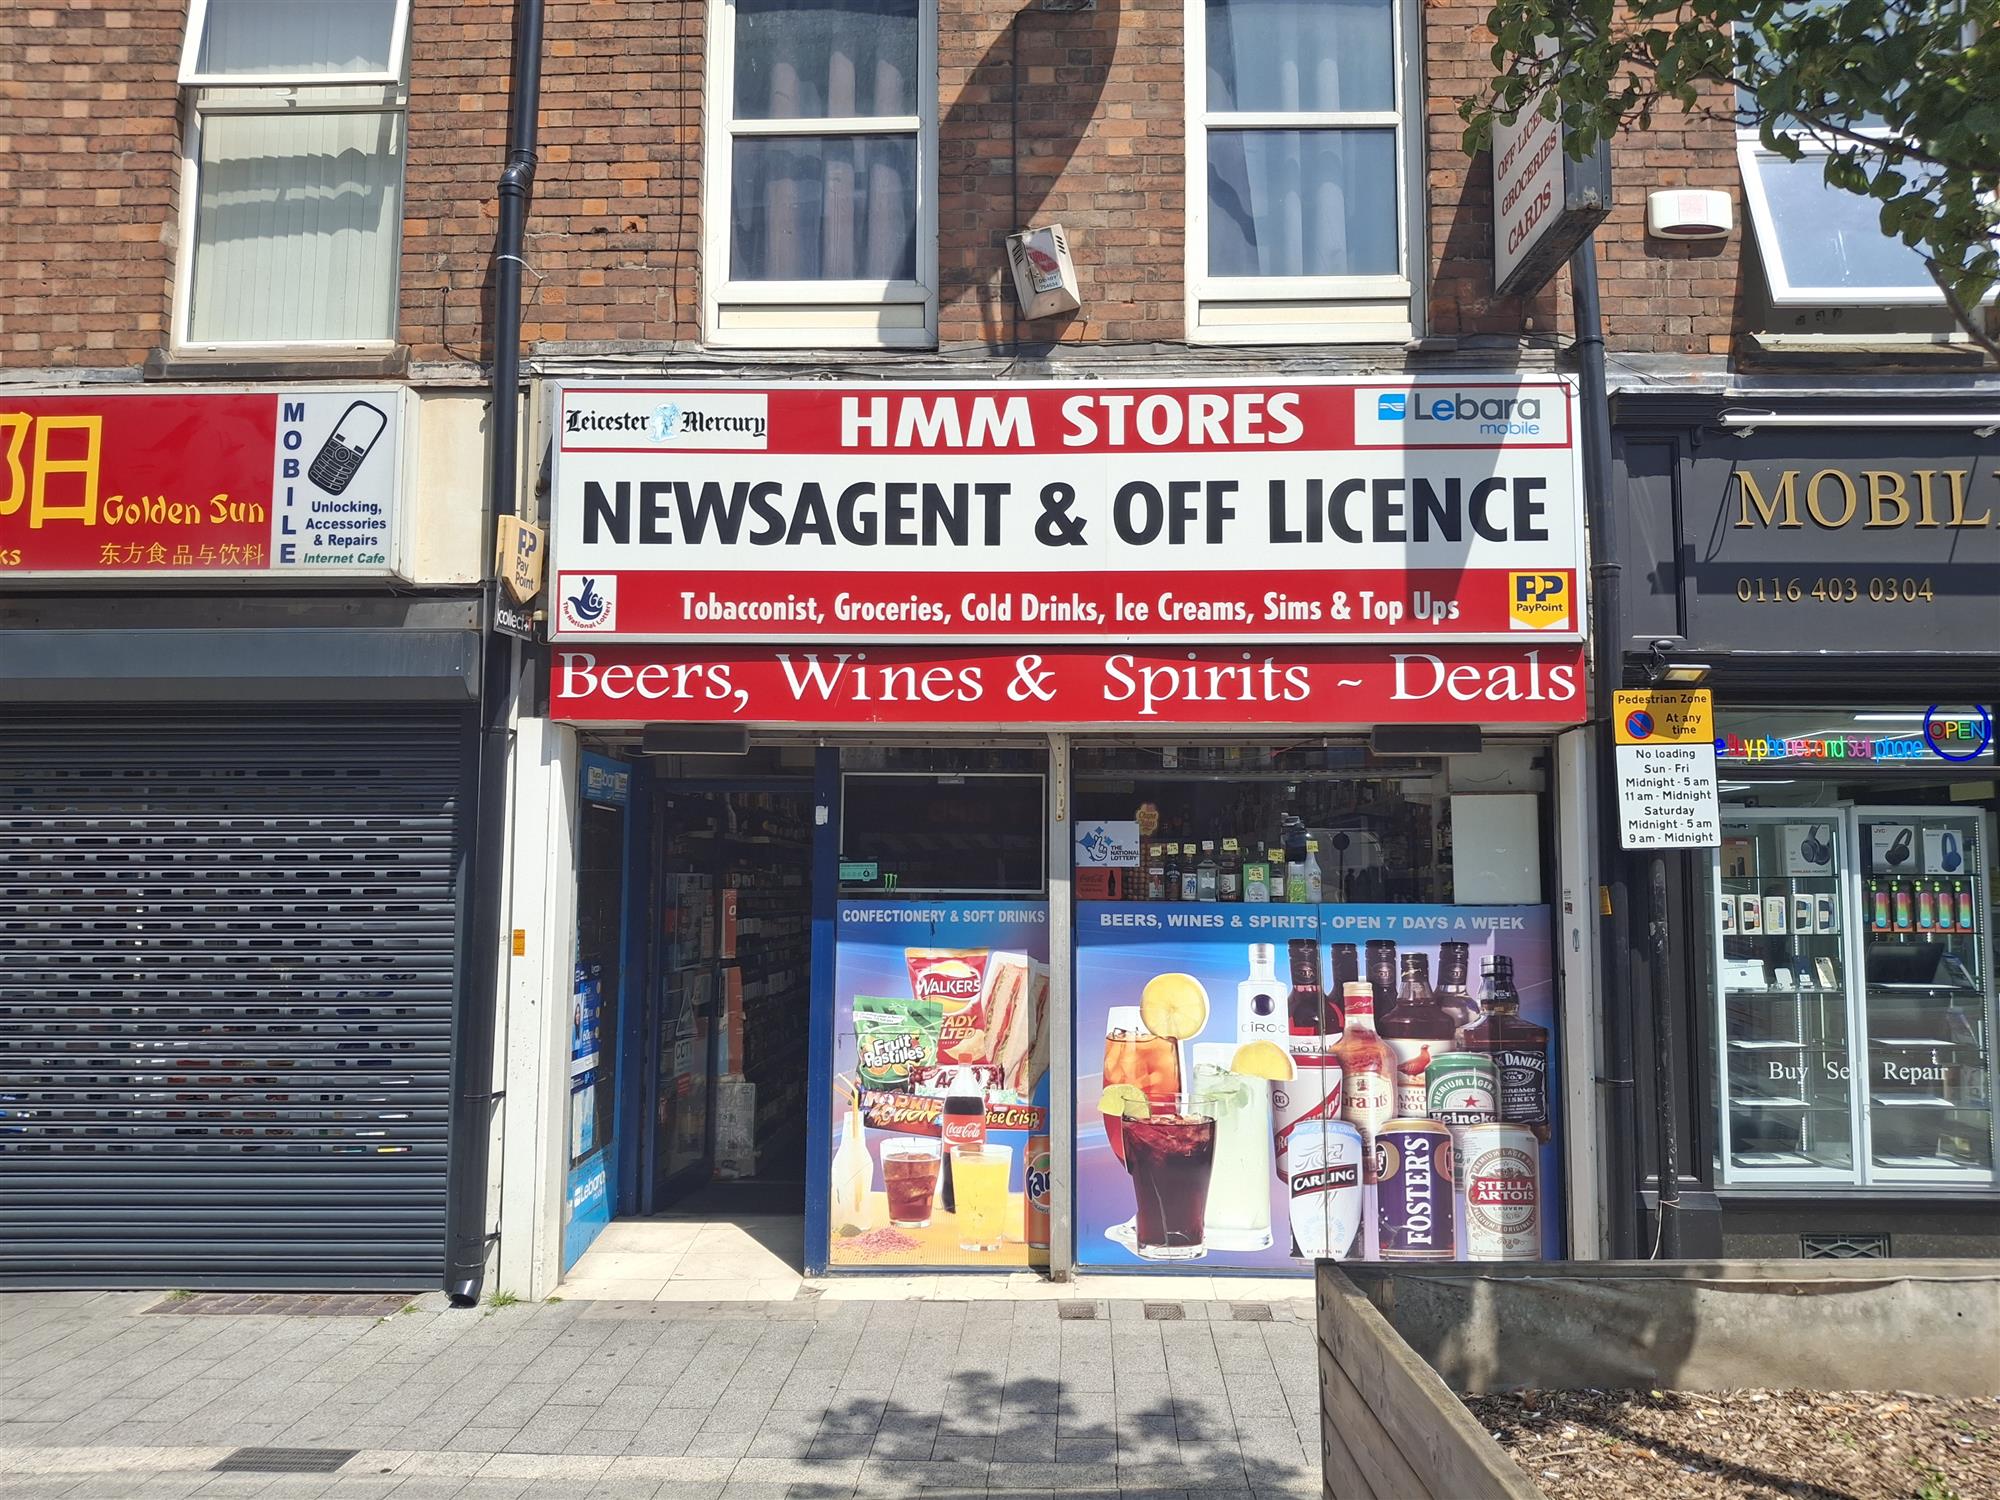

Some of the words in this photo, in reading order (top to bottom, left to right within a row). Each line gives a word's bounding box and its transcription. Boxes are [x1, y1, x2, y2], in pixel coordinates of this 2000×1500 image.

[1498, 143, 1515, 181] OFF
[1518, 110, 1542, 154] LICE
[1502, 128, 1557, 217] GROCERIES
[1508, 180, 1551, 255] CARDS
[1414, 393, 1541, 420] Lebara
[566, 410, 650, 433] Leicester
[680, 411, 766, 437] Mercury
[841, 396, 1035, 447] HMM
[1063, 393, 1304, 446] STORES
[1480, 421, 1540, 435] mobile
[280, 403, 304, 563] MOBILE
[1734, 469, 2000, 528] MOBIL
[102, 494, 201, 526] Golden
[209, 493, 265, 525] Sun
[311, 501, 382, 515] Unlocking,
[582, 481, 1011, 546] NEWSAGENT
[1034, 481, 1088, 547] &
[1113, 479, 1240, 546] OFF
[1268, 476, 1550, 545] LICENCE
[305, 518, 387, 530] Accessories
[313, 535, 323, 545] &
[328, 535, 378, 548] Repairs
[99, 542, 265, 566] 东方食品与饮料
[303, 553, 354, 564] Internet
[357, 553, 385, 564] Cafe
[516, 556, 529, 576] Pay
[515, 572, 534, 591] Point
[1736, 577, 1801, 603] 0116
[1811, 577, 1858, 603] 403
[1869, 577, 1934, 603] 0304
[562, 601, 570, 615] The
[567, 614, 596, 629] National
[597, 601, 613, 625] Lottery
[680, 592, 825, 624] Tobacconist,
[834, 592, 952, 624] Groceries,
[961, 593, 1012, 621] Cold
[1021, 593, 1105, 625] Drinks,
[1116, 592, 1149, 621] Ice
[1157, 592, 1255, 624] Creams,
[1263, 591, 1322, 620] Sims
[1330, 591, 1351, 620] &
[1359, 591, 1403, 625] Top
[1413, 590, 1460, 624] Ups
[1516, 603, 1563, 613] PayPoint
[556, 651, 750, 713] Beers,
[775, 652, 983, 702] Wines
[1006, 653, 1058, 702] &
[1103, 652, 1311, 715] Spirits
[1389, 650, 1577, 702] Deals
[1618, 694, 1677, 704] Pedestrian
[1680, 694, 1707, 704] Zone
[1665, 713, 1680, 723] At
[1682, 714, 1702, 725] any
[1672, 726, 1697, 735] time
[1928, 720, 1985, 740] OPEN
[1636, 749, 1652, 759] No
[1655, 749, 1696, 760] loading
[1756, 734, 1812, 762] phones
[1815, 735, 1845, 758] and
[1875, 738, 1923, 763] phone
[1644, 764, 1666, 774] Sun
[1675, 763, 1690, 773] Fri
[1626, 778, 1675, 789] Midnight
[1684, 777, 1691, 786] 5
[1693, 778, 1709, 786] am
[1625, 791, 1634, 800] 11
[1637, 793, 1654, 801] am
[1662, 790, 1712, 802] Midnight
[1644, 806, 1695, 817] Saturday
[1628, 819, 1678, 831] Midnight
[1686, 819, 1694, 828] 5
[1696, 820, 1712, 828] am
[1629, 833, 1636, 843] 9
[1638, 835, 1655, 843] am
[1664, 832, 1714, 844] Midnight
[842, 909, 947, 923] CONFECTIONERY
[950, 910, 960, 922] &
[962, 910, 995, 923] SOFT
[998, 910, 1045, 923] DRINKS
[1100, 913, 1162, 928] BEERS,
[1167, 914, 1224, 928] WINES
[1230, 914, 1243, 928] &
[1249, 915, 1318, 929] SPIRITS
[1331, 916, 1381, 929] OPEN
[1386, 916, 1396, 929] 7
[1402, 916, 1449, 930] DAYS
[1453, 917, 1467, 930] A
[1471, 917, 1525, 930] WEEK
[916, 972, 981, 996] WALKERS
[940, 1028, 976, 1040] LTED
[874, 1034, 912, 1055] Fruit
[1289, 1044, 1309, 1053] CHO
[864, 1047, 925, 1067] Pastilles
[1767, 1061, 1808, 1085] Buy
[1827, 1061, 1850, 1080] Se
[1882, 1061, 1949, 1085] Repair
[1399, 1095, 1426, 1103] AMO
[1433, 1078, 1465, 1105] PREMIUM
[1466, 1076, 1494, 1091] LAGER
[1399, 1103, 1426, 1111] ROU
[1431, 1112, 1498, 1125] Heineke
[945, 1122, 980, 1139] Coca-Cola
[1293, 1169, 1355, 1192] CARLING
[1477, 1180, 1534, 1191] STELLA
[1404, 1137, 1432, 1245] FOSTER'S
[1477, 1190, 1534, 1201] ARTOIS
